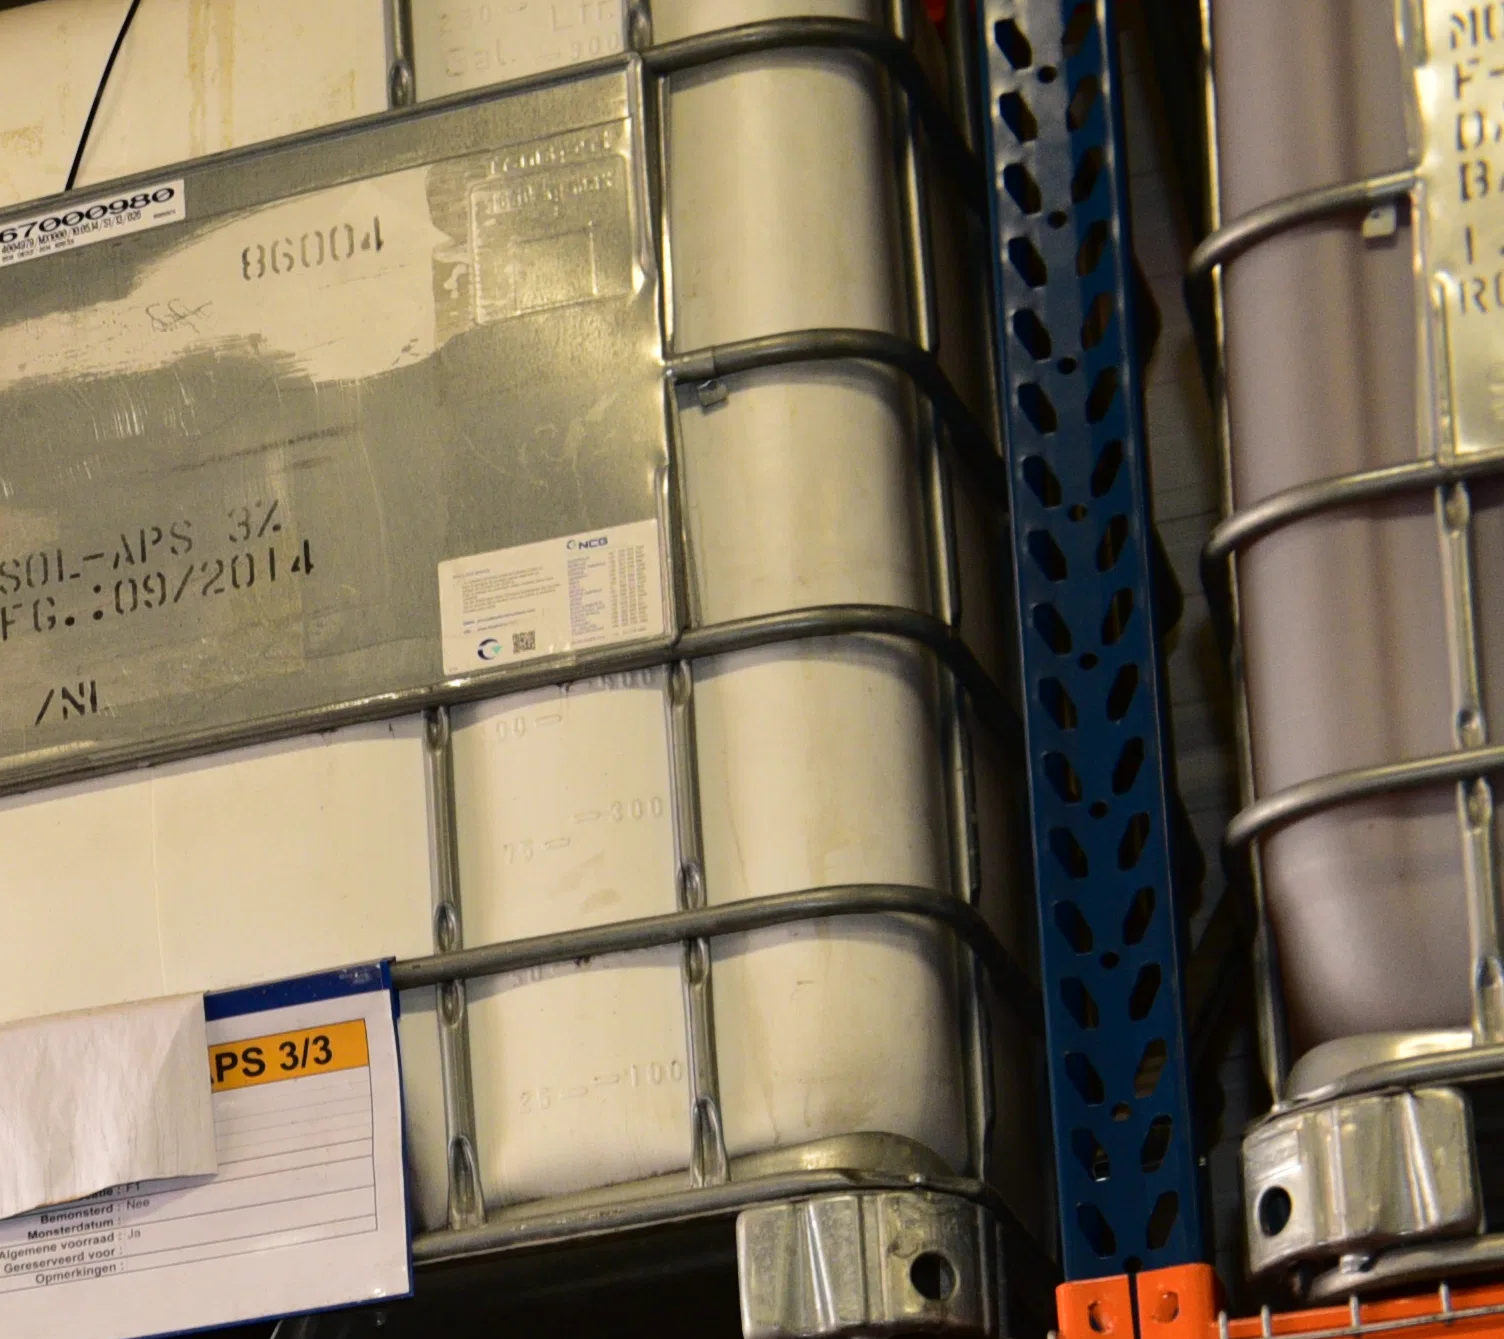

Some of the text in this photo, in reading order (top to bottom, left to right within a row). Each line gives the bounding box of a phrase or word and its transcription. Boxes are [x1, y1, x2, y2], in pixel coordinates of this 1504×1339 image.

[242, 216, 385, 282] 86004
[229, 500, 282, 542] 3%
[578, 537, 608, 550] NCG
[210, 1035, 333, 1086] PS 3/3
